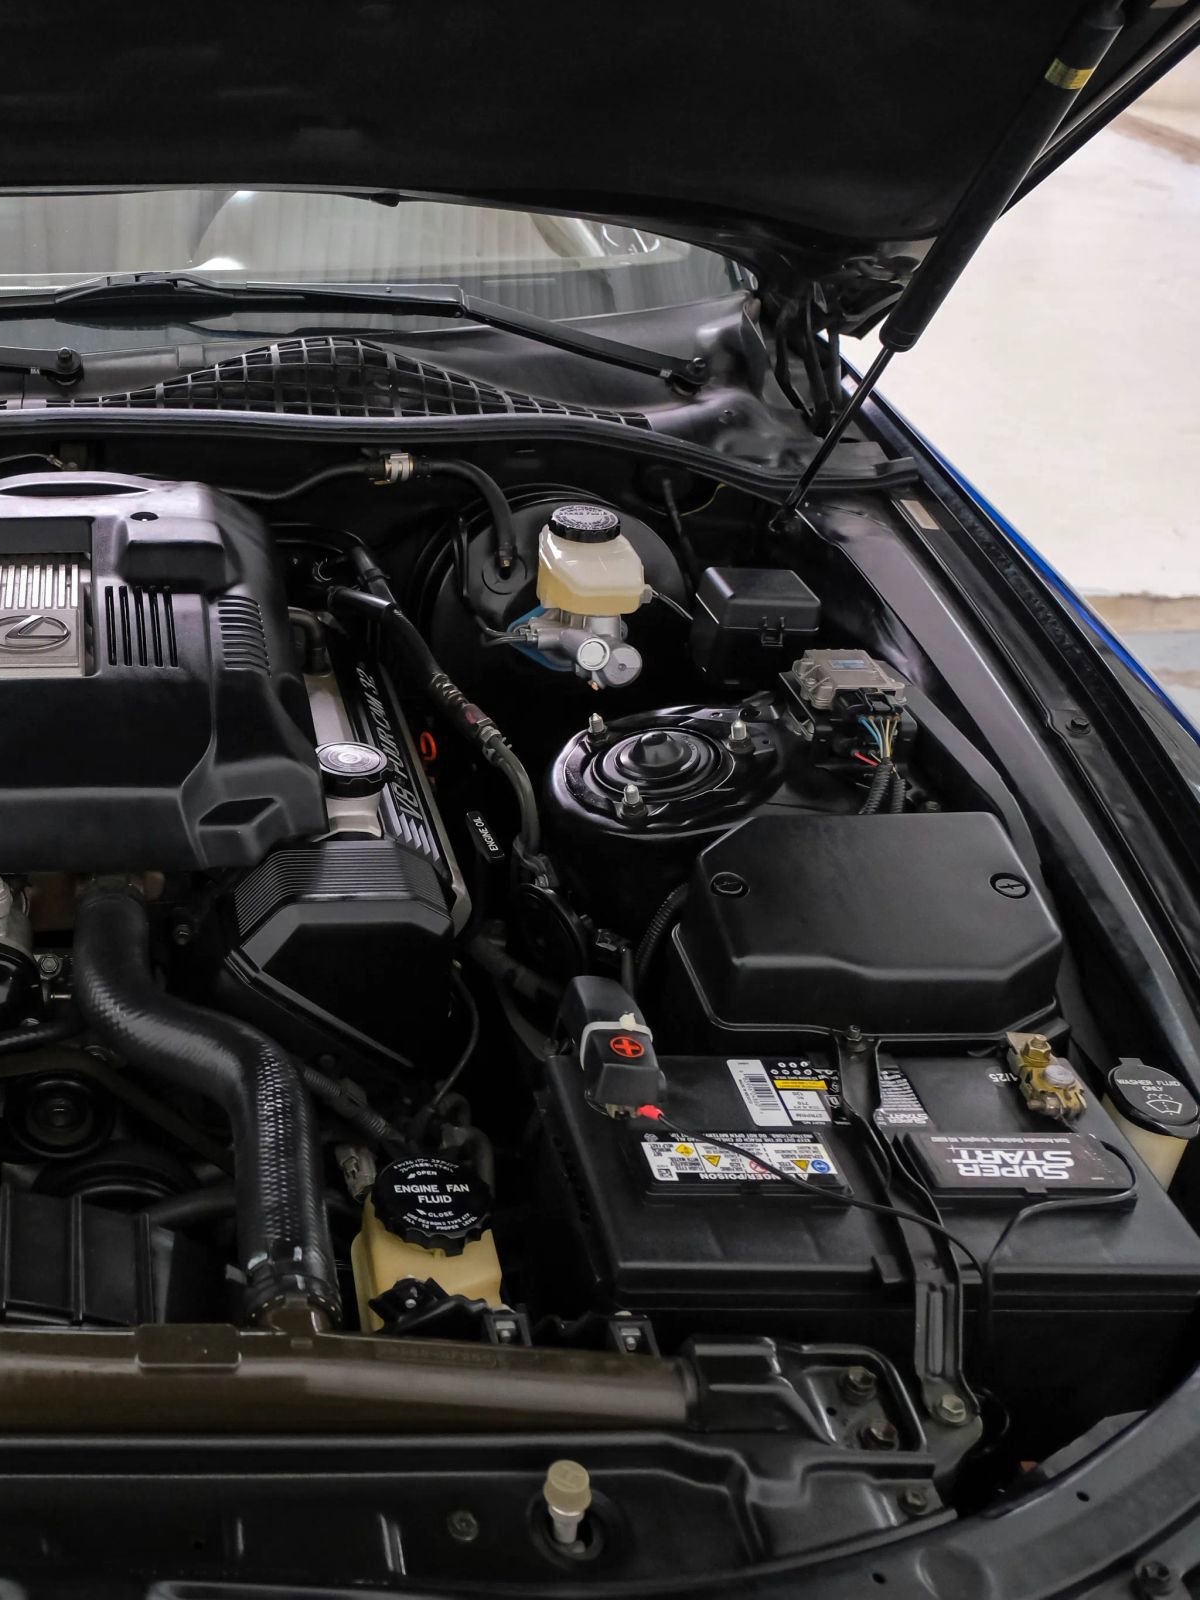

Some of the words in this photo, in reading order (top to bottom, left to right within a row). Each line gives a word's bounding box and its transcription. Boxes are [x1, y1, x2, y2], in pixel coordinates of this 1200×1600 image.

[356, 667, 379, 696] 32
[391, 782, 423, 820] V8
[473, 816, 485, 827] OIL
[478, 826, 499, 851] ENGINE
[951, 1150, 1075, 1168] START
[956, 1163, 1070, 1180] SUPER
[394, 1184, 440, 1193] ENGINE
[446, 1183, 470, 1193] FAN
[417, 1194, 452, 1204] FLUID
[427, 1210, 454, 1218] CLOSE
